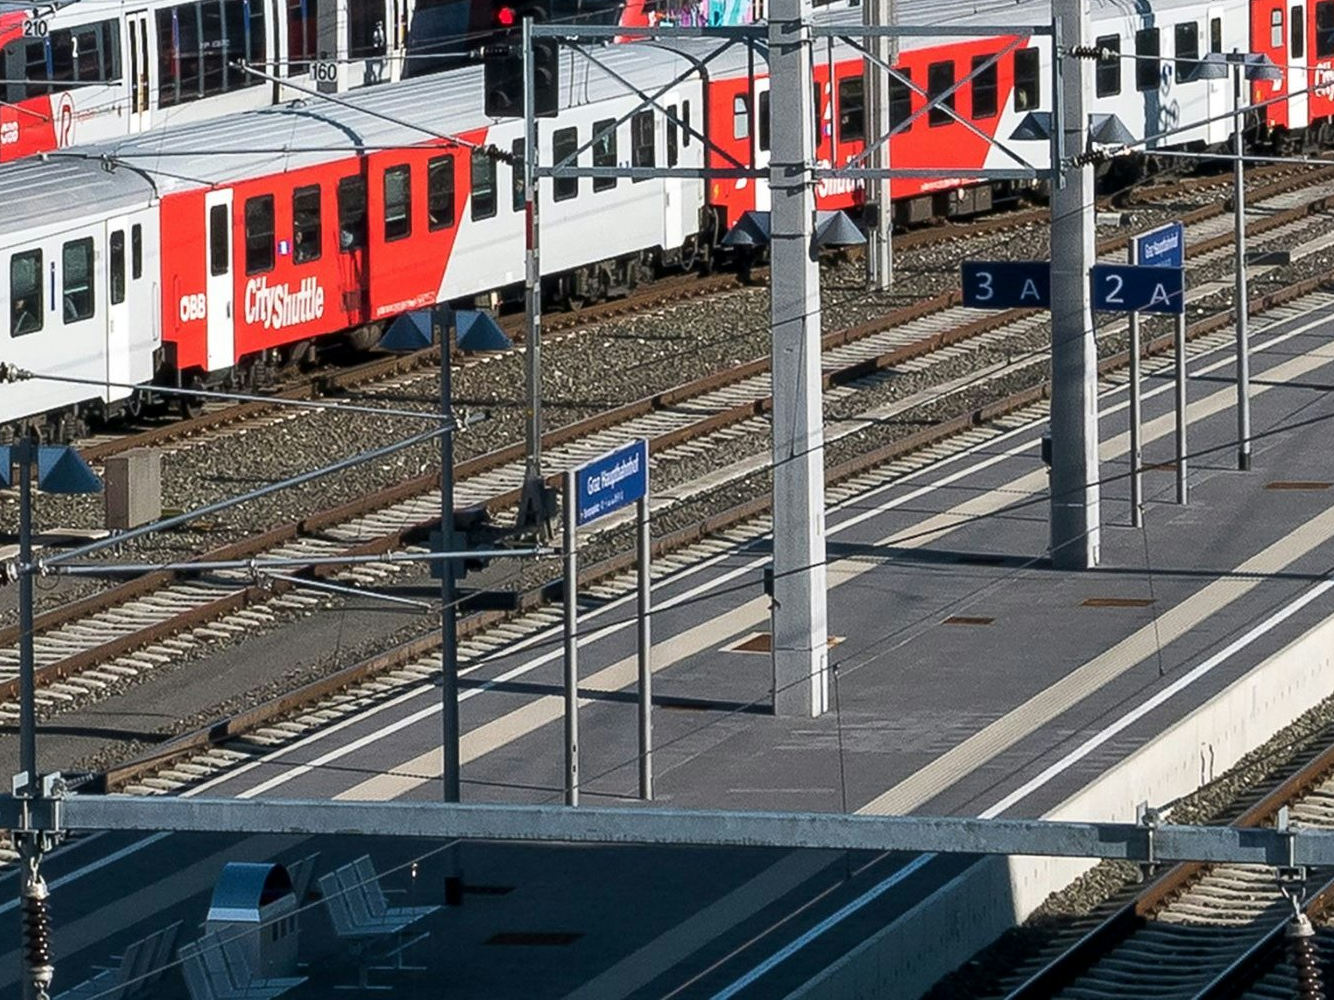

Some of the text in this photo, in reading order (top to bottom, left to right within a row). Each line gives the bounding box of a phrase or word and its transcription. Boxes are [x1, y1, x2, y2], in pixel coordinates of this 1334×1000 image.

[24, 20, 48, 36] 210
[311, 63, 338, 80] 160
[975, 272, 1040, 300] 3 A
[1105, 274, 1170, 305] 2 A
[245, 276, 325, 330] CityShuttle
